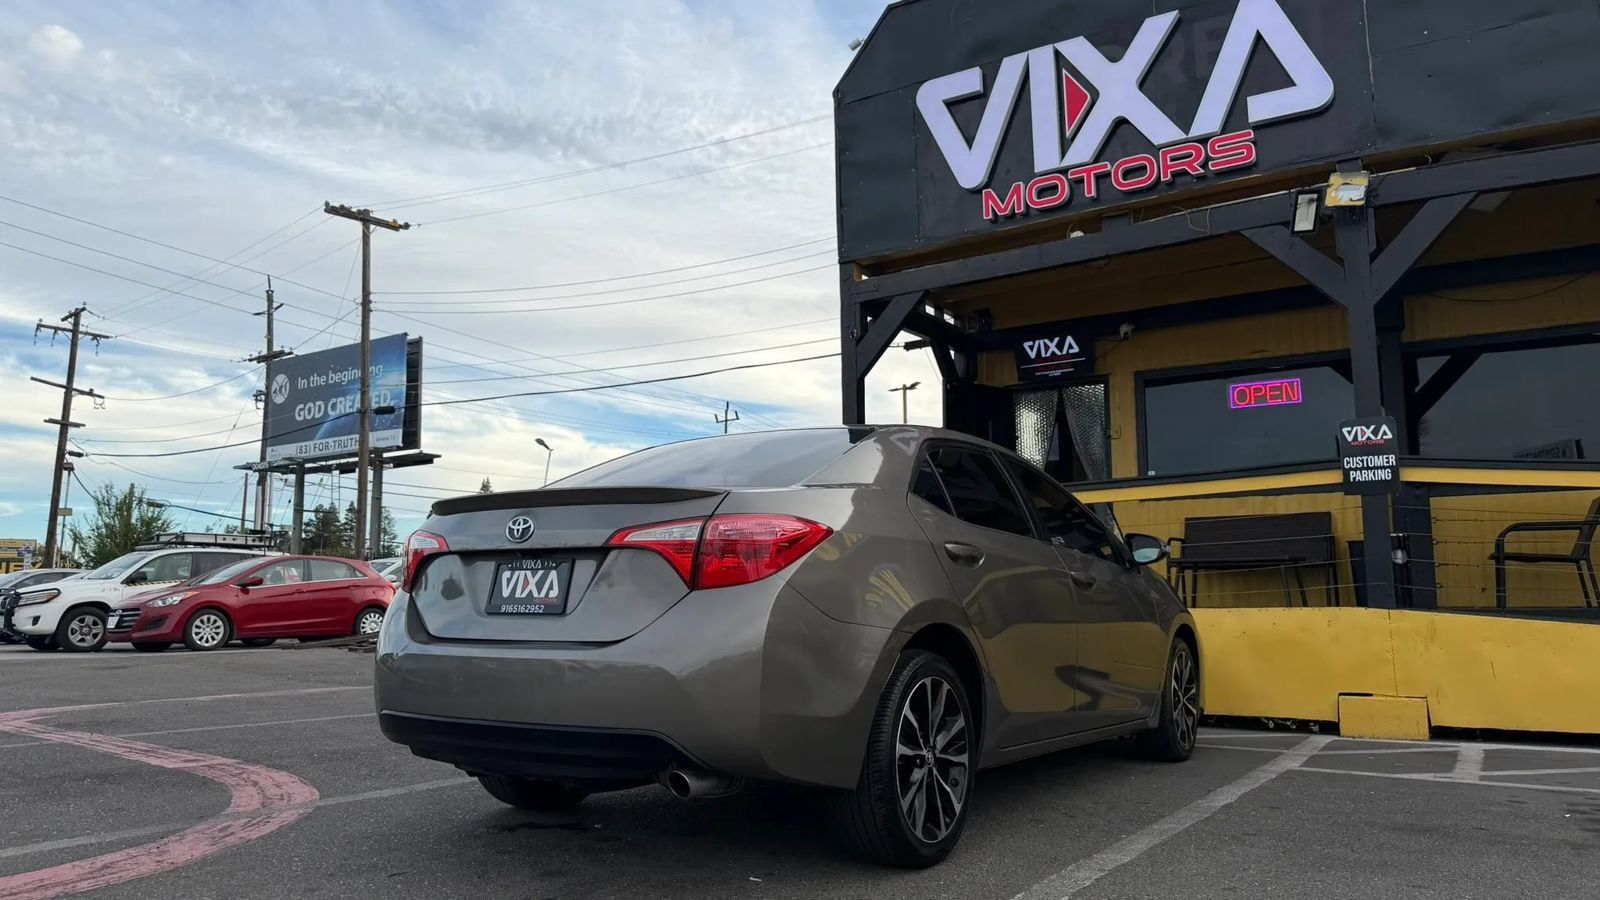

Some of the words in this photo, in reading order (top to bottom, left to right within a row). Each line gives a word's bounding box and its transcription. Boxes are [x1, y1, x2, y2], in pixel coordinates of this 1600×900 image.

[916, 0, 1335, 190] VIXA
[982, 129, 1256, 221] MOTORS
[1023, 335, 1079, 358] VIXA
[298, 376, 307, 390] In
[310, 373, 326, 387] the
[1234, 382, 1298, 405] OPEN
[295, 400, 325, 421] GOD
[328, 390, 394, 415] CREAED.
[1342, 424, 1393, 441] VIXA
[295, 444, 311, 455] (83)
[1343, 455, 1396, 468] CUSTOMER
[1350, 469, 1391, 482] PARKING
[522, 560, 541, 568] VIXA
[502, 570, 558, 597] VIXA
[501, 605, 544, 613] 9165162952
